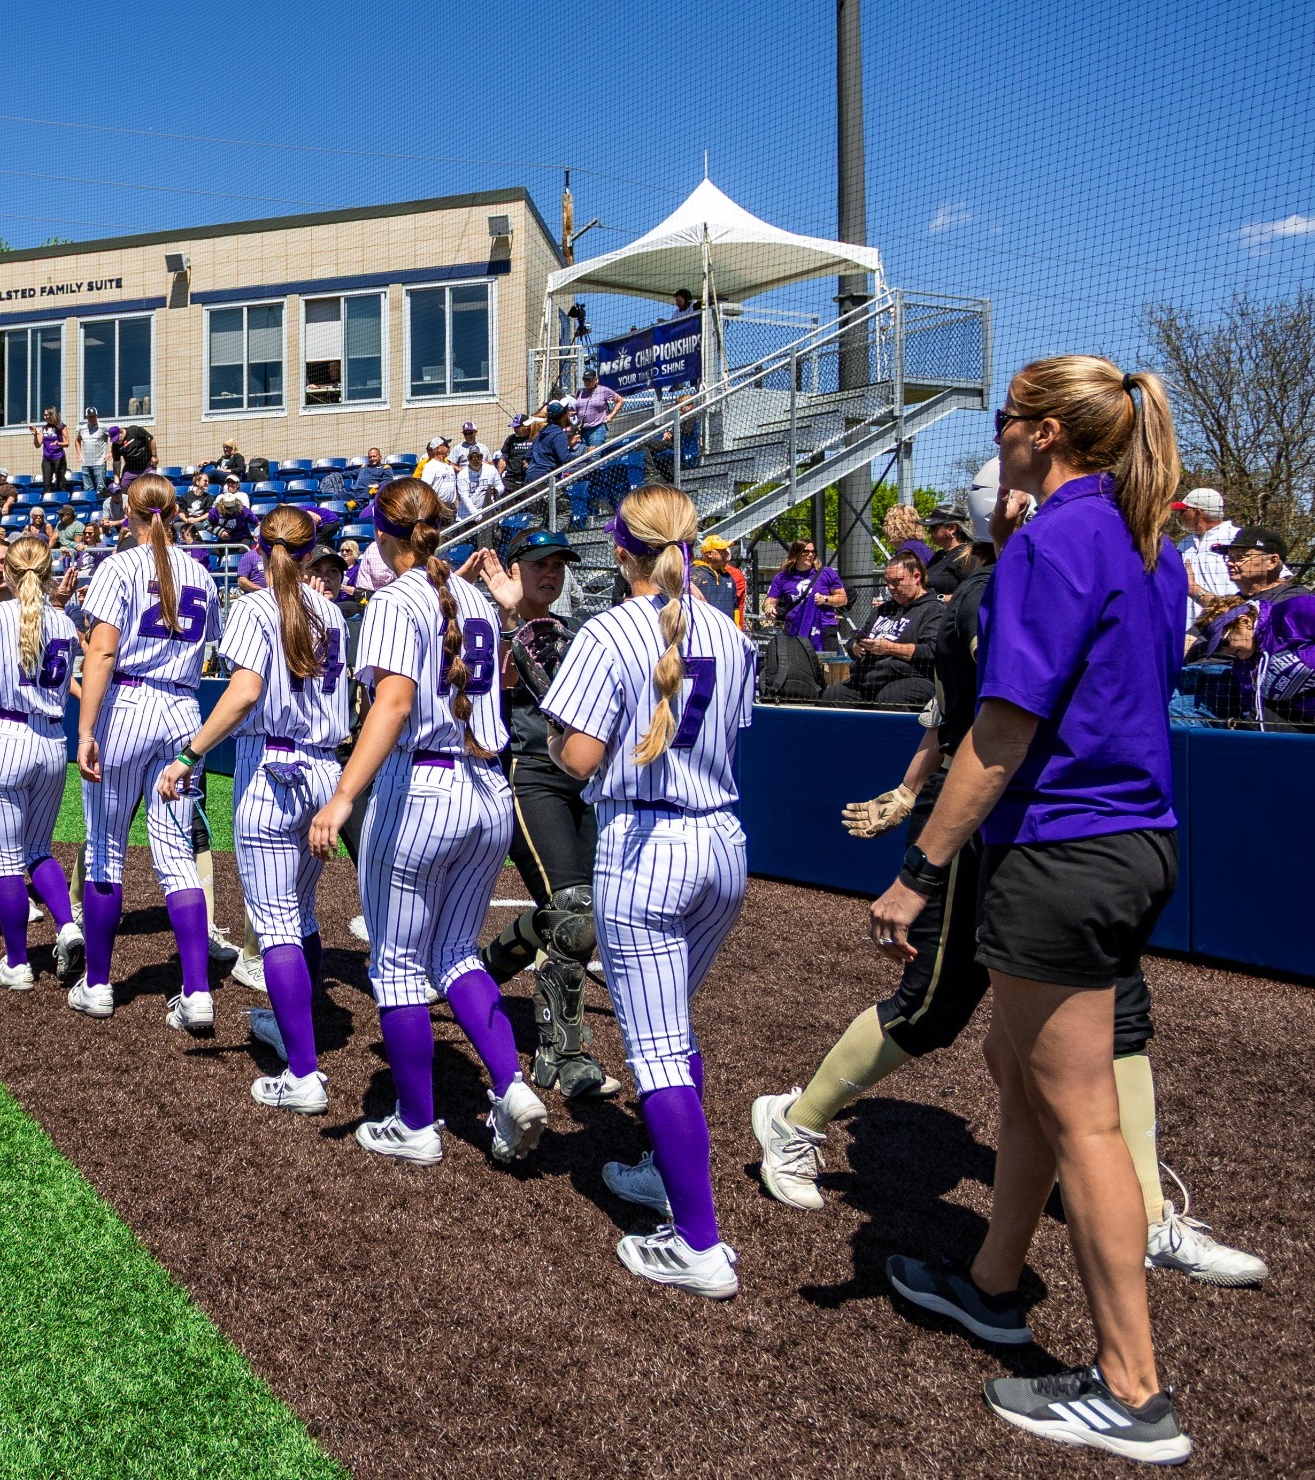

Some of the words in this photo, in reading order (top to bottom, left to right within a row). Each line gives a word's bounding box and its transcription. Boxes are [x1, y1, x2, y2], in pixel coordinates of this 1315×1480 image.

[40, 282, 84, 297] FAMILY
[87, 277, 123, 292] SUITE
[618, 373, 637, 387] YOUR
[661, 359, 685, 375] SHINE
